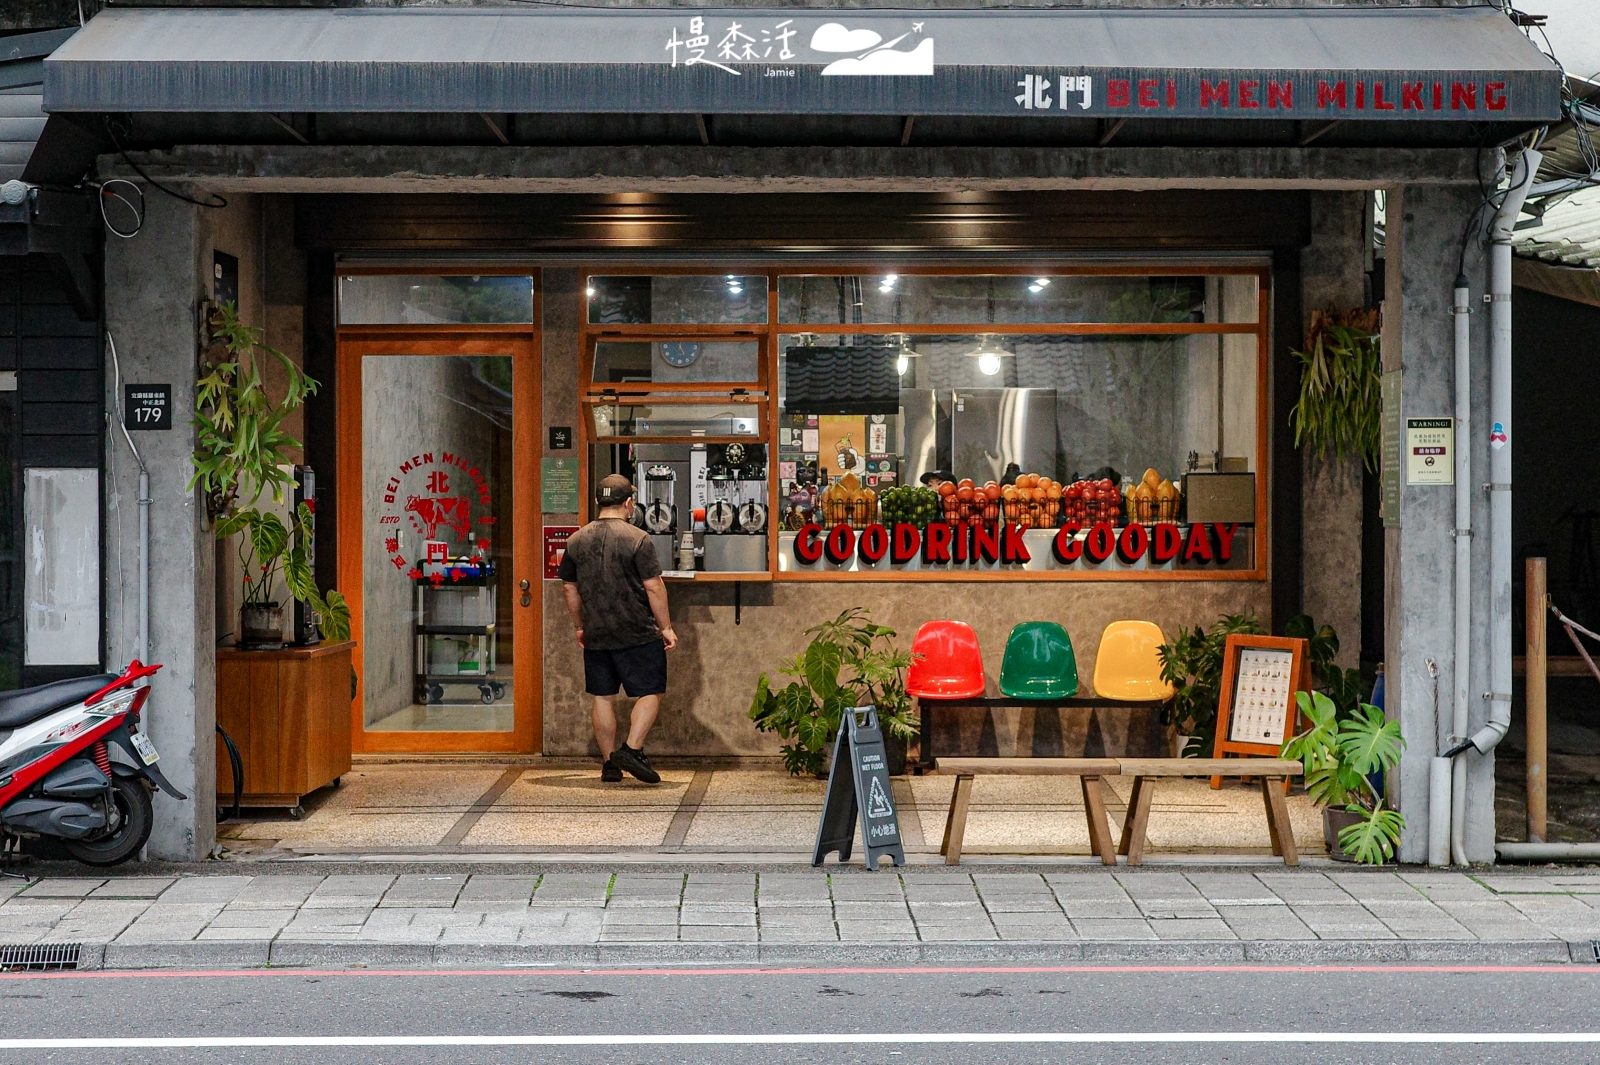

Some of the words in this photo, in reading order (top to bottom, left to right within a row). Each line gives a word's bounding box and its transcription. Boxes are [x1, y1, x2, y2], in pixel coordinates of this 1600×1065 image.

[1014, 74, 1092, 110] 北門
[1107, 79, 1177, 109] BEI
[1200, 79, 1293, 109] MEN
[1317, 80, 1507, 111] MILKING
[134, 407, 163, 423] 179
[384, 476, 401, 504] BEI
[399, 452, 434, 475] MEN
[442, 452, 492, 506] MILKING
[425, 471, 450, 494] 北
[380, 516, 401, 524] ESTD
[427, 543, 449, 565] 門
[794, 522, 1032, 564] GOODRINK
[1054, 521, 1239, 564] GOODAY
[871, 823, 896, 837] 小心地滑
